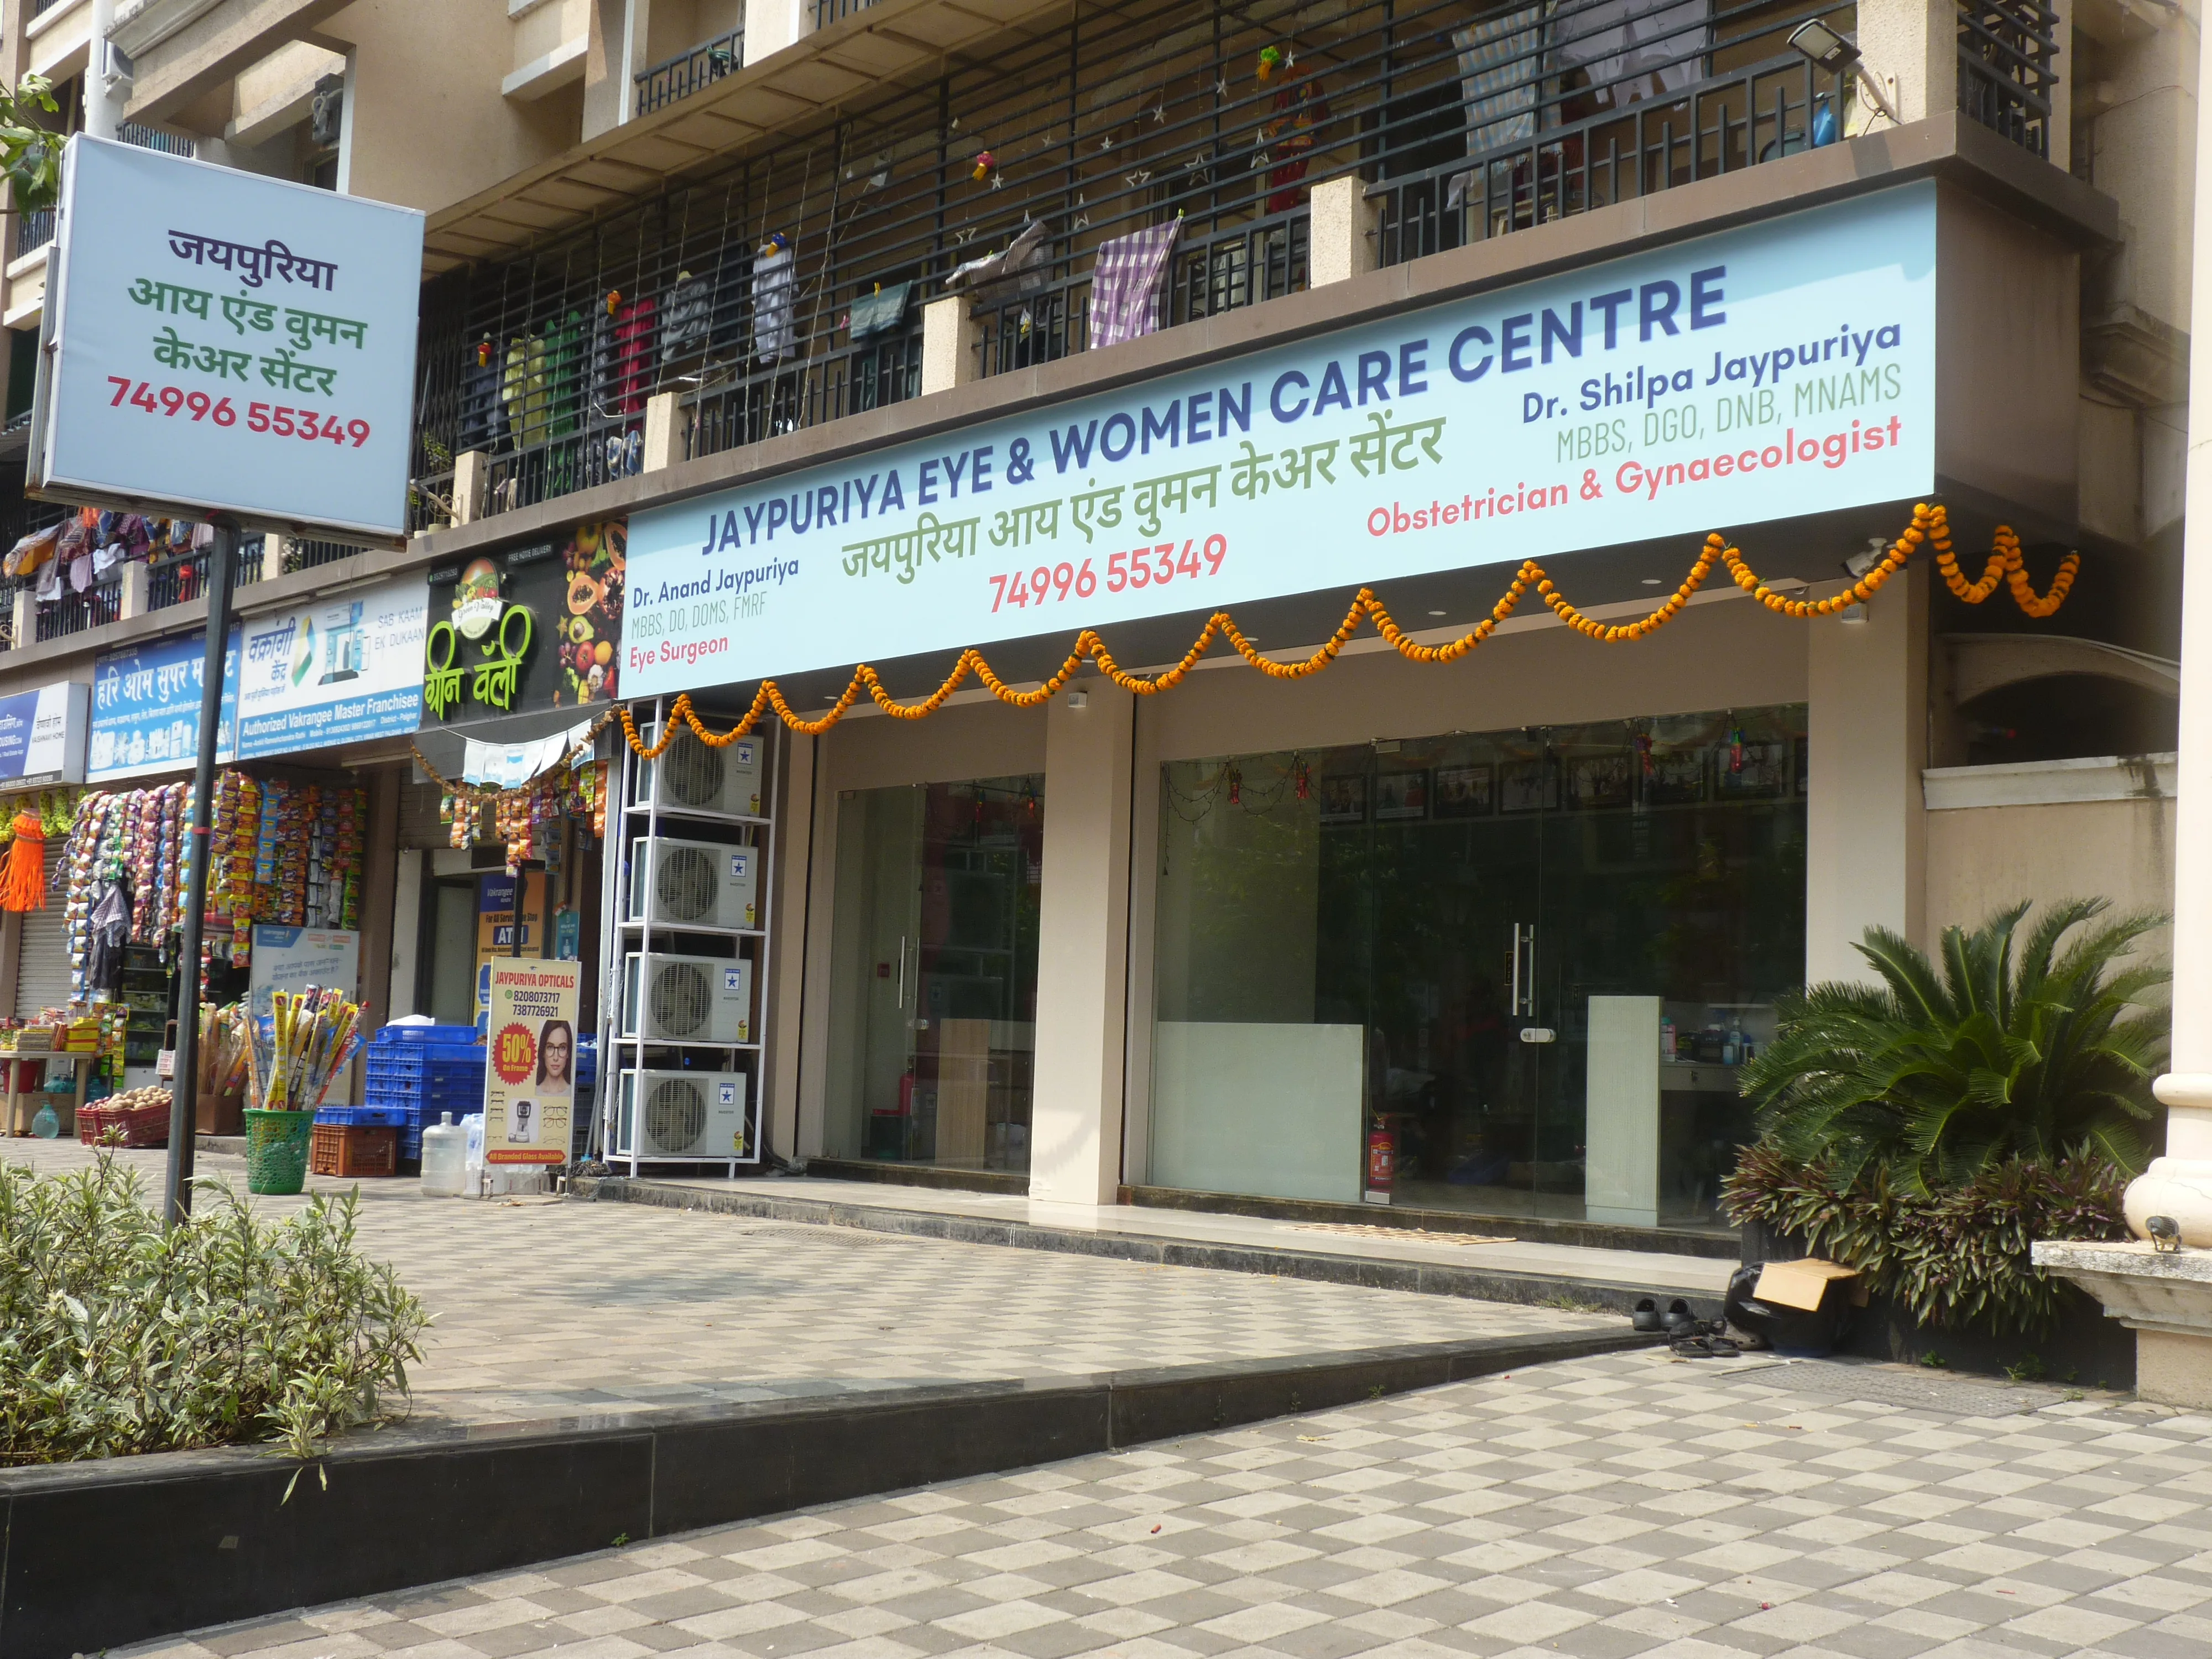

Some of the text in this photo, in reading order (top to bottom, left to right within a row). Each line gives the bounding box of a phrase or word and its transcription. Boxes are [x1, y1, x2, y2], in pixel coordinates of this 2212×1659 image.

[168, 230, 338, 291] जयपुरिया
[128, 279, 368, 351] आय एंड वुमन
[153, 327, 337, 397] केअर सेंटर
[1524, 324, 1901, 423] Dr. Shilpa Jaypuriya
[108, 376, 371, 448] 74996 55349
[702, 264, 1726, 555] JAYPURIYA EYE & WOMEN CARE CENTRE
[1557, 363, 1901, 463] MBBS, DGO, DNB, MNAMS
[842, 409, 1447, 584] जयपुरिया आय एंड वुमन केअर सेंटर
[1367, 416, 1902, 537] Obstetrician & Gynaecologist
[633, 557, 799, 608] Dr. Anand Jaypuriya
[989, 533, 1227, 613] 74996 55349
[375, 627, 425, 650] EK DUKAAN
[378, 606, 422, 628] SAB KAAM
[632, 590, 768, 639] MBBS, DO, DOMS, FMRF
[630, 637, 728, 674] Eye Surgeon
[97, 665, 121, 710] हरि
[123, 658, 155, 702] ओम
[157, 660, 189, 702] सुपर
[243, 692, 419, 737] Authorized Vakrangee Master Franchisee
[495, 971, 574, 989] JAYPURIYA OPTICALS
[514, 990, 560, 1004] 8208073717
[513, 1004, 558, 1017] 7387726921
[502, 1034, 531, 1063] 50%
[538, 1152, 563, 1161] Available
